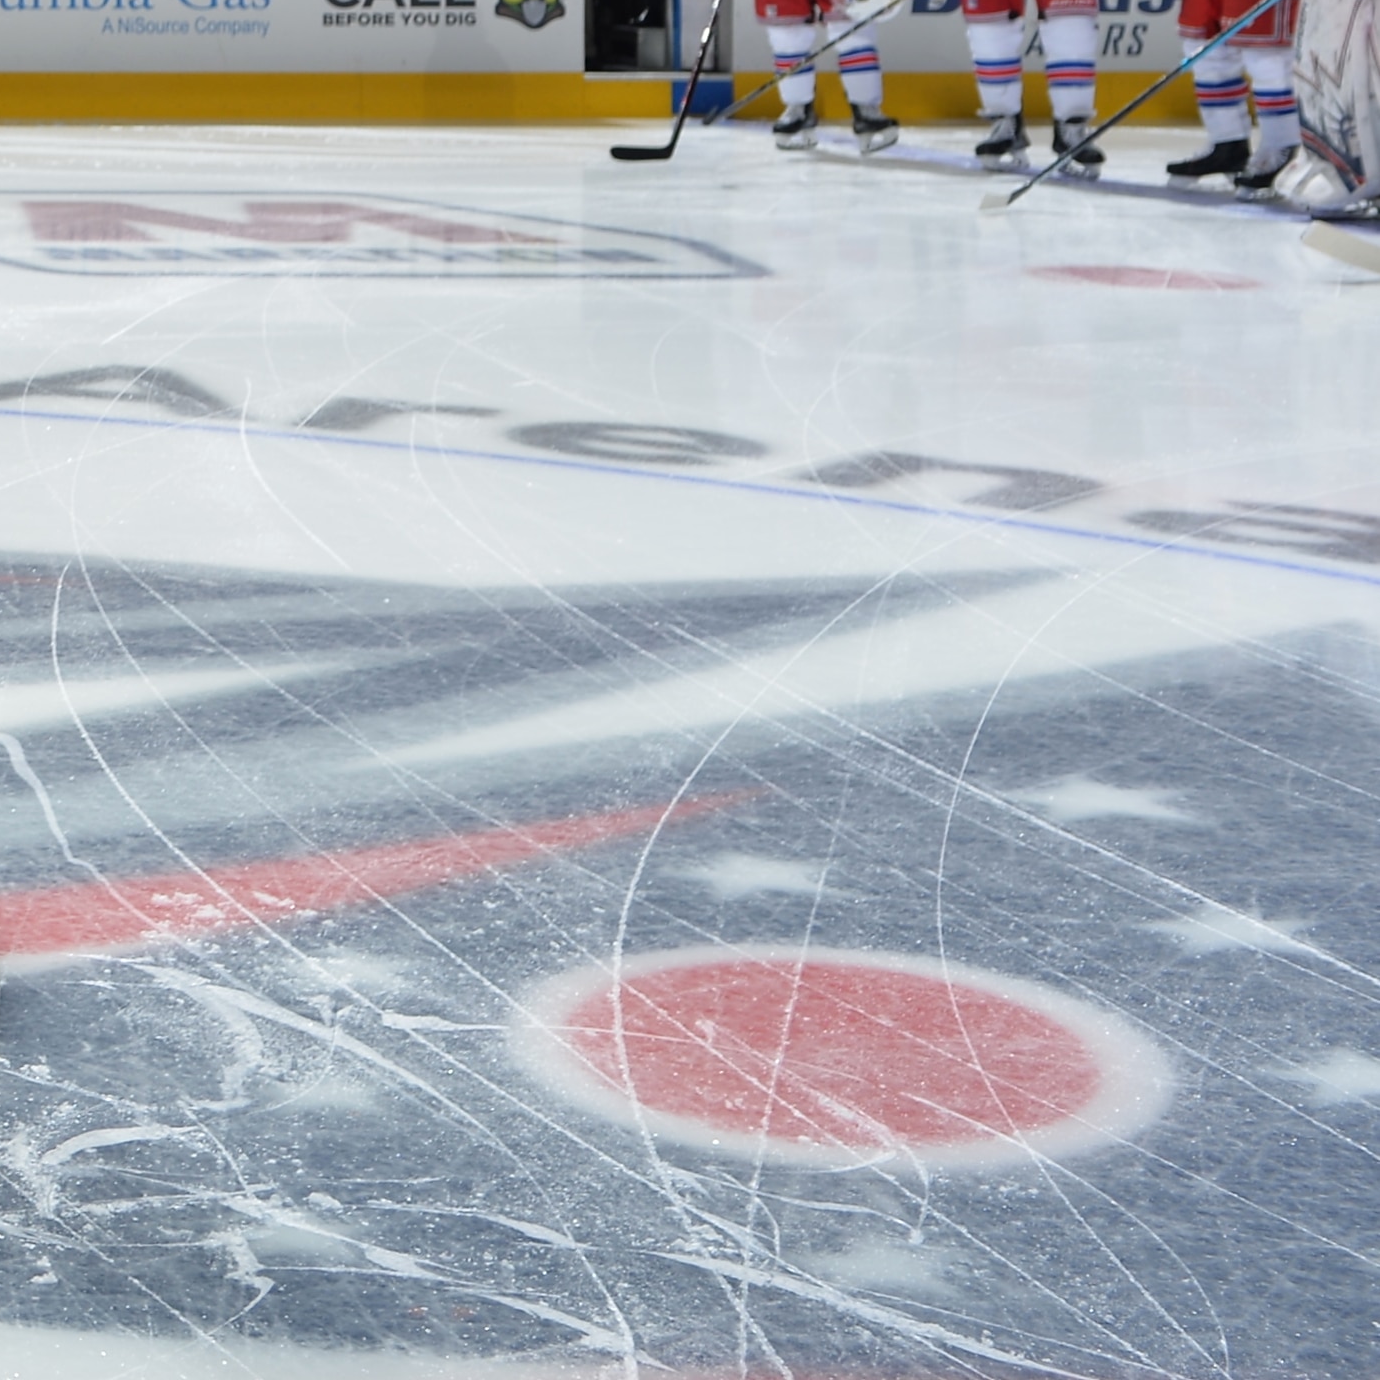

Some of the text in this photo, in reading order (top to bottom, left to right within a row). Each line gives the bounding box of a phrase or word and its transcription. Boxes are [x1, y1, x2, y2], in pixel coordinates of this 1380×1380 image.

[102, 16, 271, 38] A NiSource Company
[322, 12, 477, 27] BEFORE YOU DIG
